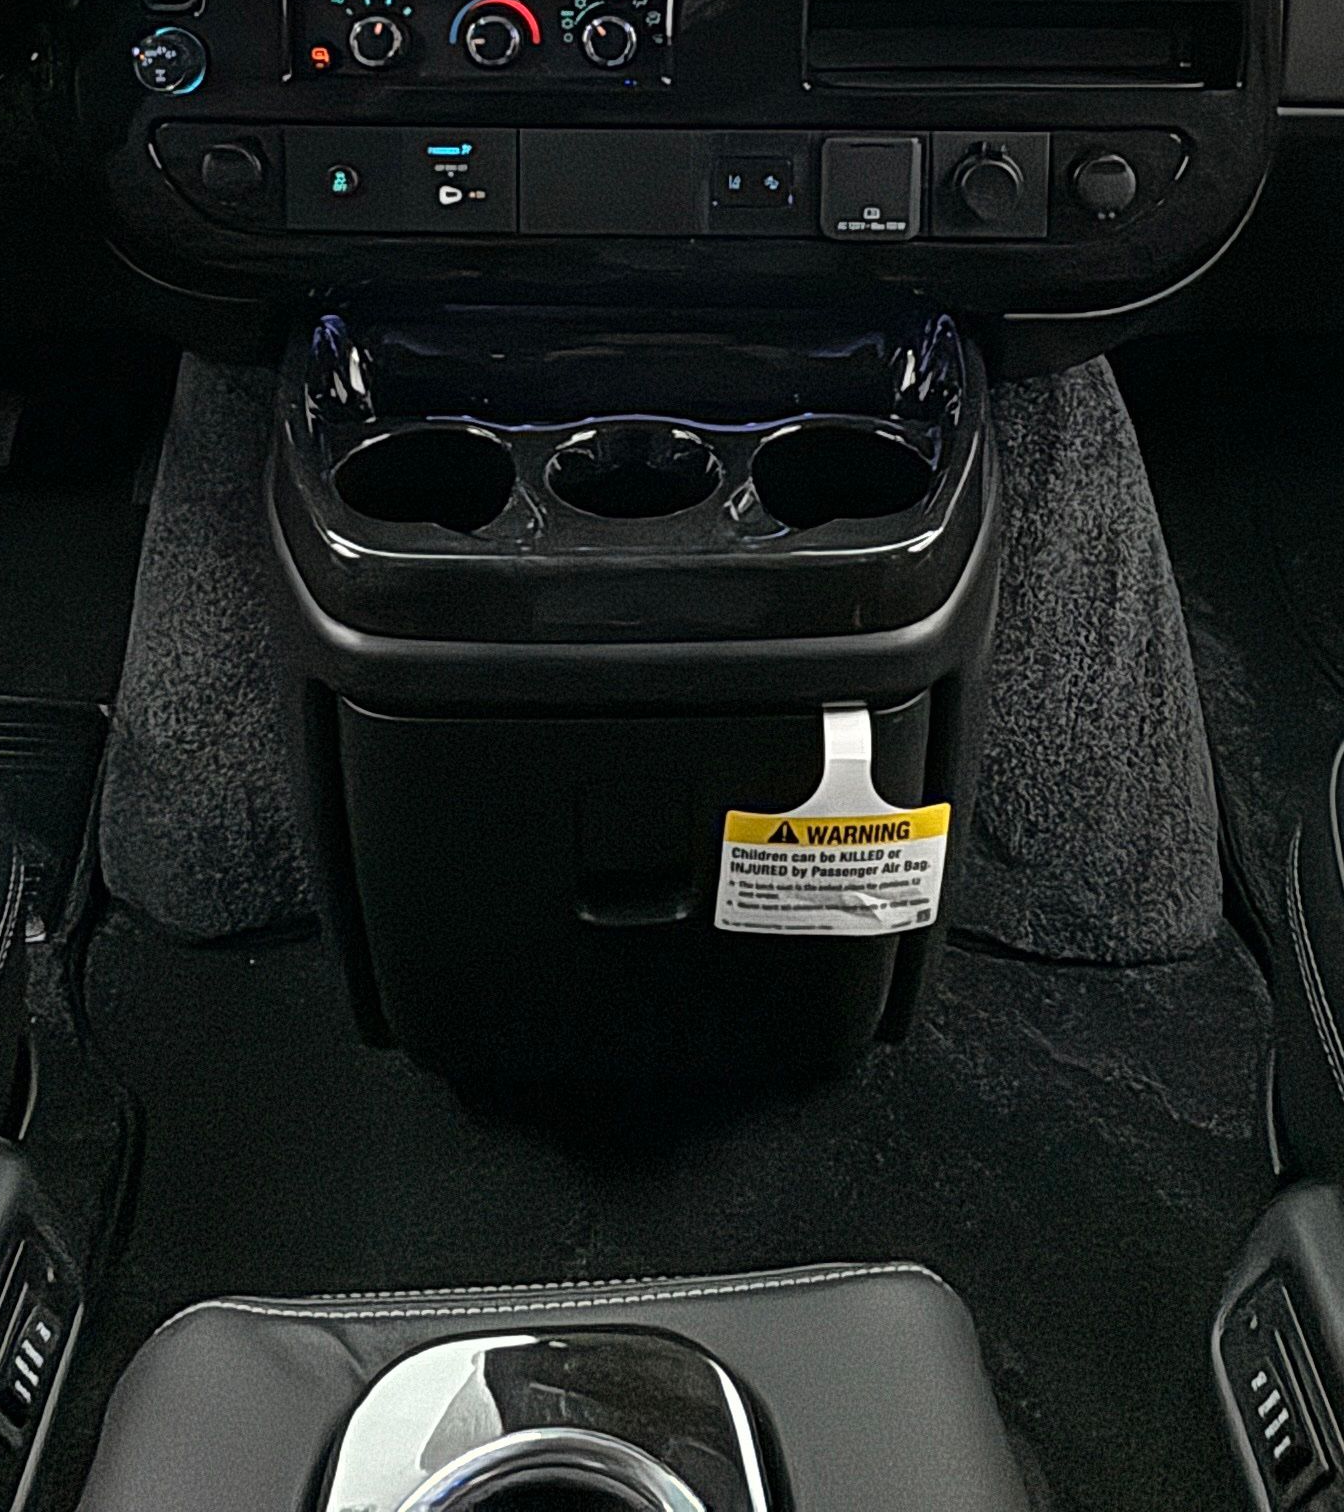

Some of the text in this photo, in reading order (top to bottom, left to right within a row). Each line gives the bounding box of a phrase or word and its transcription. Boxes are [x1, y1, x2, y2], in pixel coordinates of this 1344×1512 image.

[807, 820, 911, 845] WARNING
[731, 847, 902, 863] Children can be KILLED or
[730, 861, 788, 877] INJURED
[792, 865, 808, 879] by
[811, 865, 879, 878] Passenger
[881, 862, 902, 874] Air
